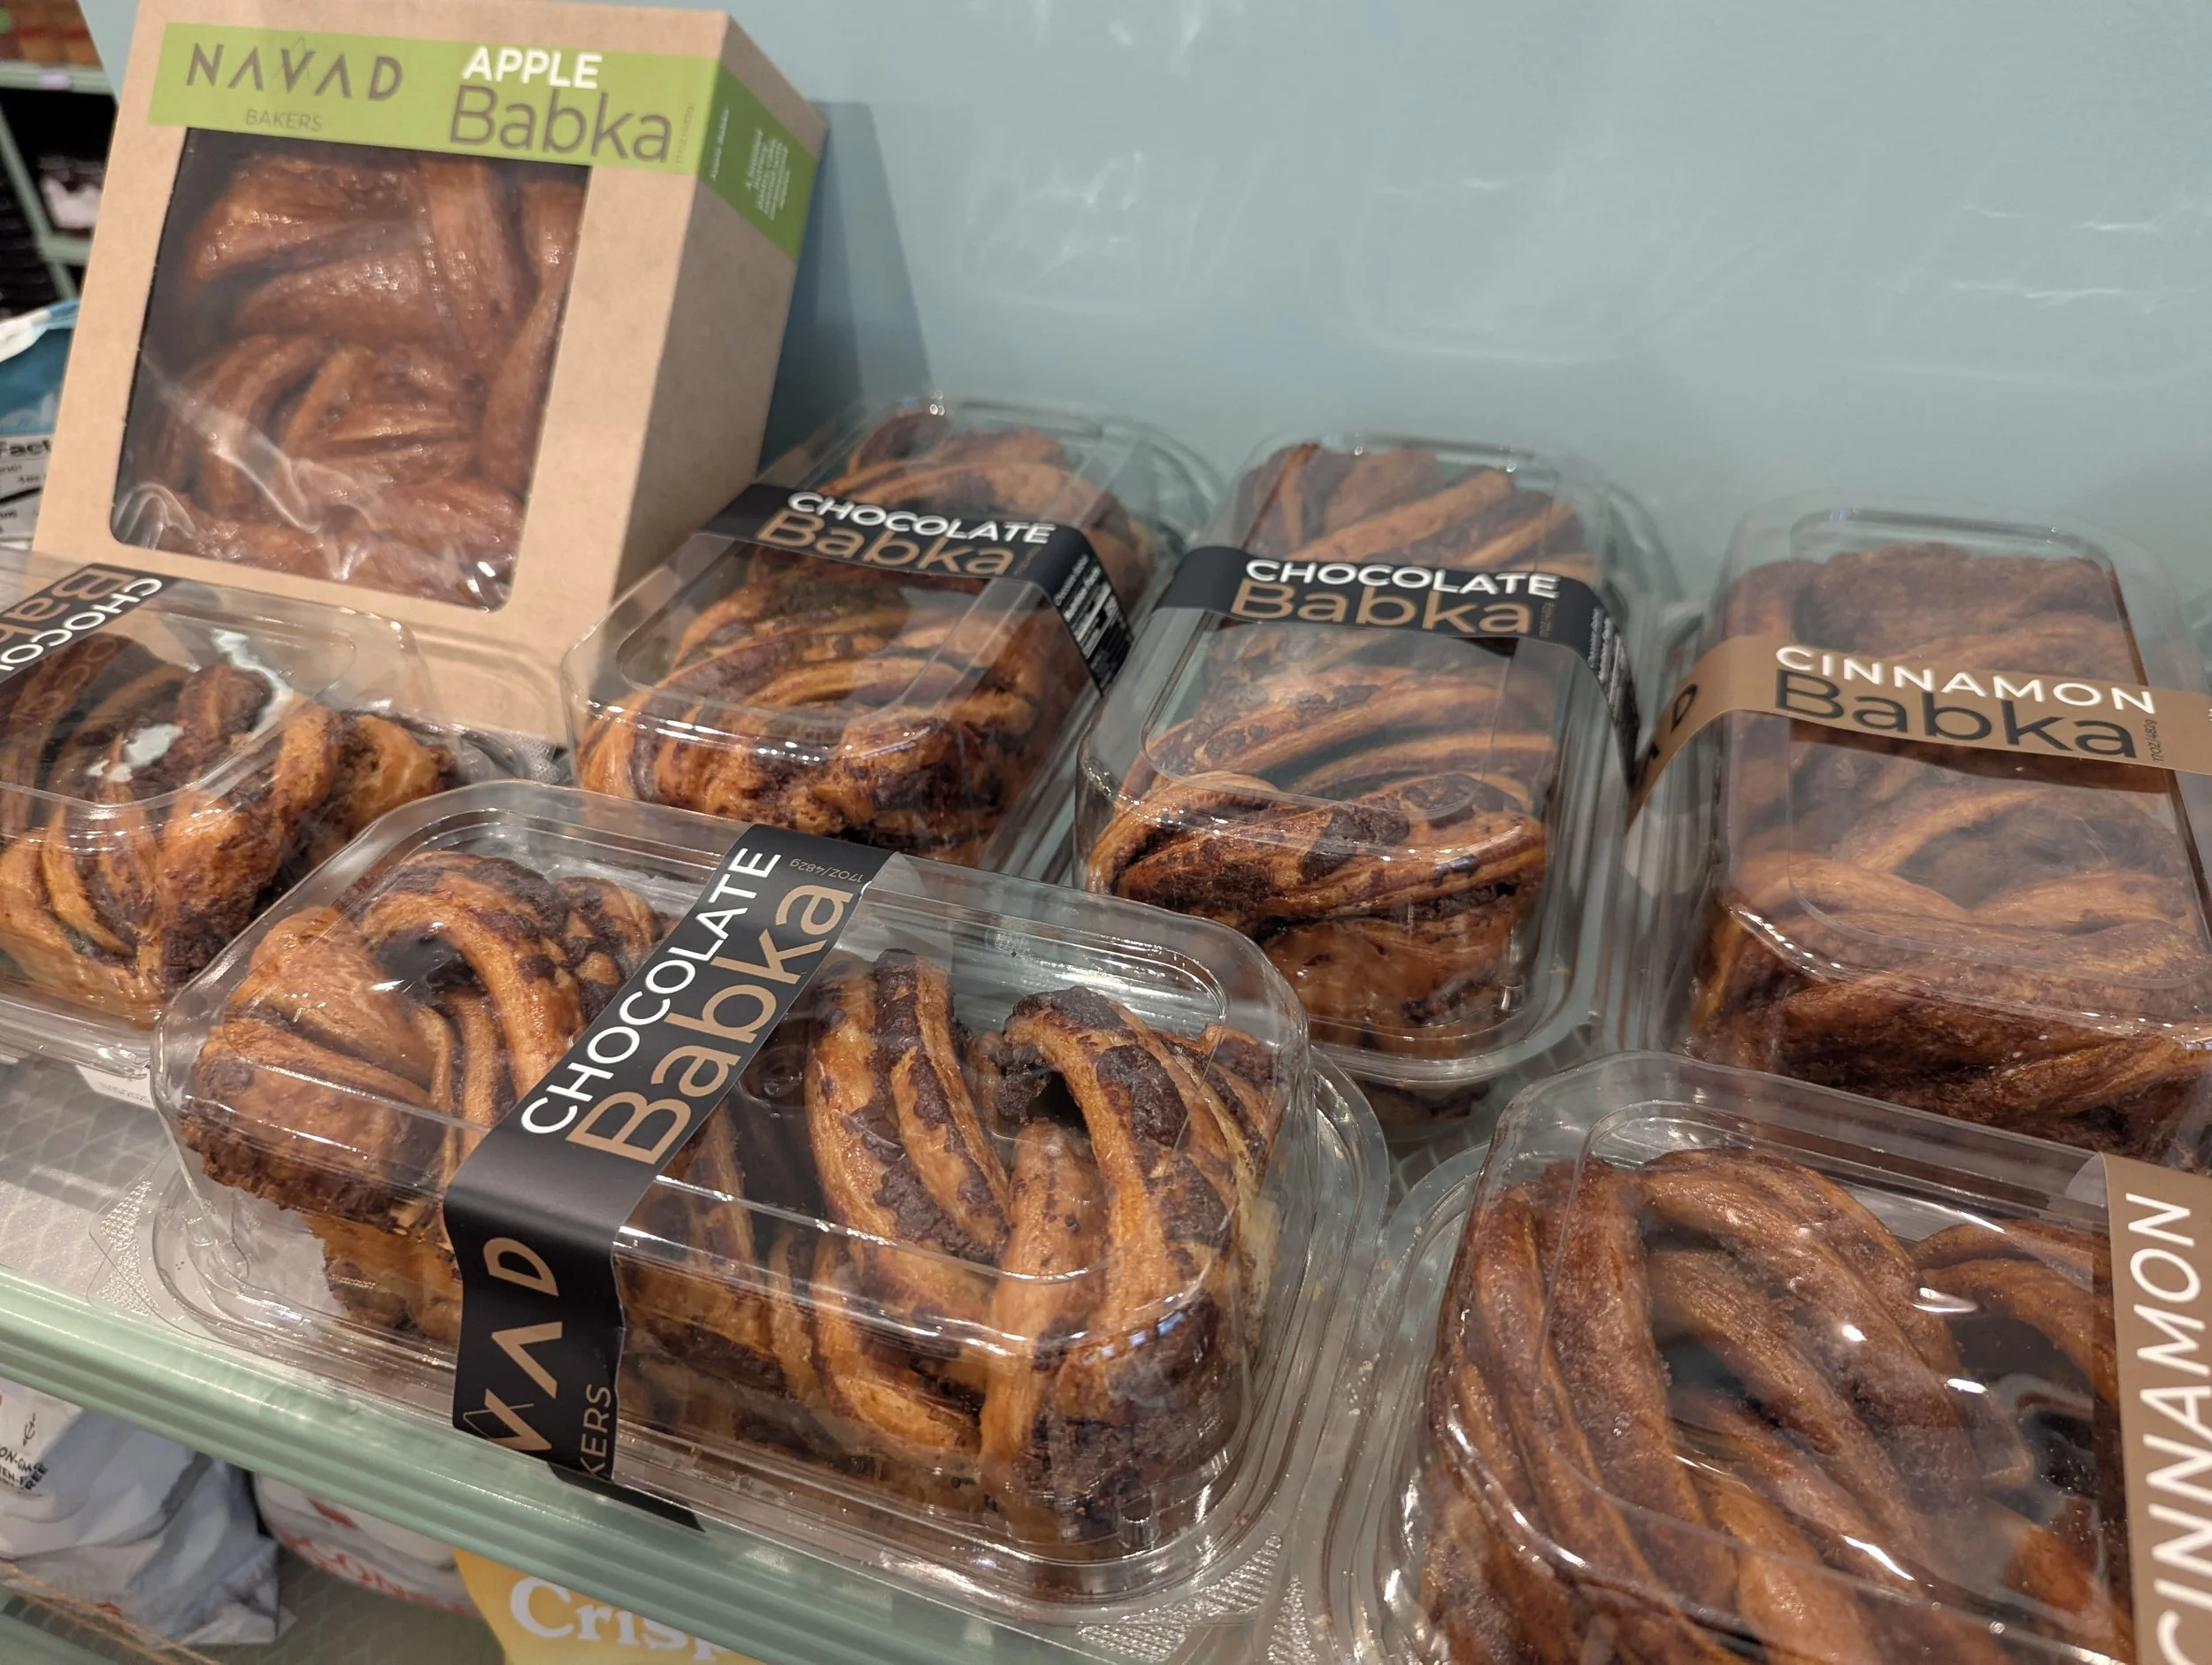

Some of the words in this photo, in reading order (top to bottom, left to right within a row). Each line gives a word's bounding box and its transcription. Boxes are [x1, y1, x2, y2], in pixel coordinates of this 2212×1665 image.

[462, 45, 603, 88] APPLE
[244, 109, 323, 132] BAKERS
[449, 84, 673, 164] Babka
[757, 508, 1014, 576] Babka
[787, 491, 1056, 544] CHOCOLATE
[1230, 577, 1536, 634] Babka
[1246, 558, 1562, 600] CHOCOLATE
[1775, 645, 2156, 715] CINNAMON
[1775, 668, 2137, 759] Babka
[520, 847, 781, 1134] CHOCOLATE
[565, 884, 853, 1165] Babka
